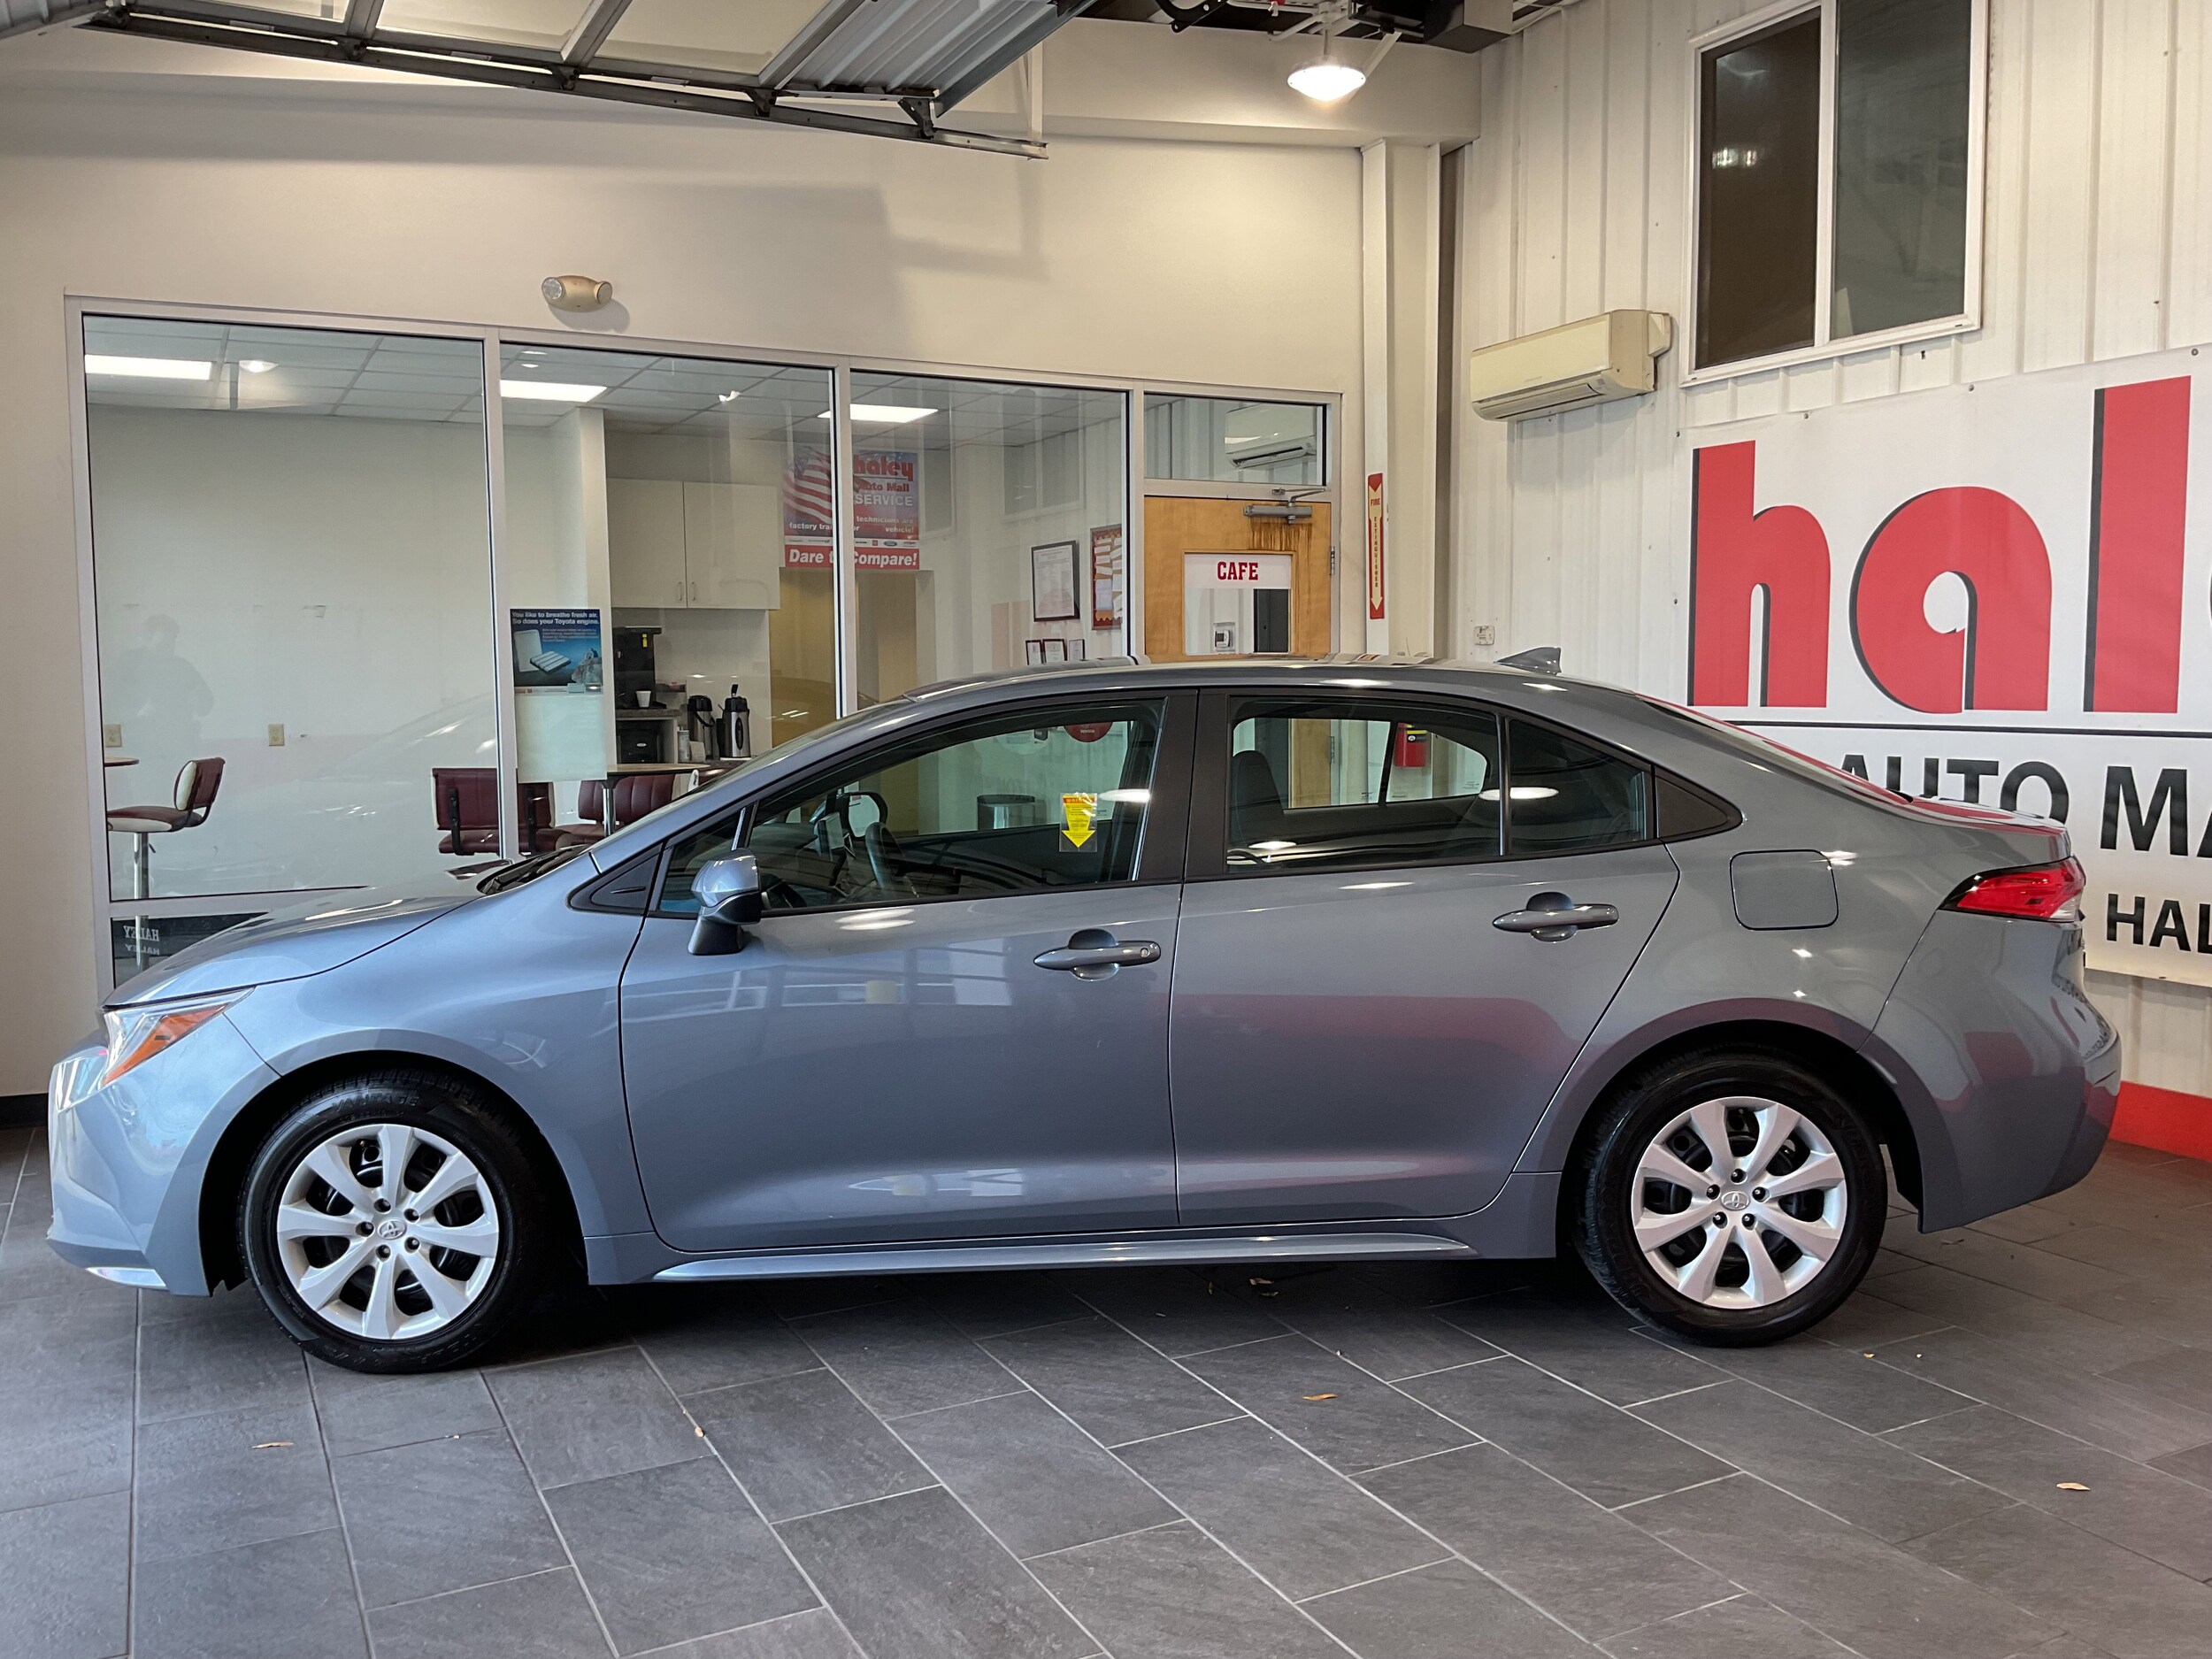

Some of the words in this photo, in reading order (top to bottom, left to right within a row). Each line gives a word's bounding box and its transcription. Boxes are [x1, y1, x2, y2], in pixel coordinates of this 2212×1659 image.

[853, 454, 914, 481] haley
[887, 482, 910, 492] Mall
[854, 494, 914, 506] SERVICE
[1371, 498, 1380, 507] FIRE
[789, 521, 817, 531] factory
[1687, 375, 2212, 714] hal
[789, 549, 824, 564] Dare
[1217, 561, 1259, 580] CAFE
[2100, 765, 2212, 858] M
